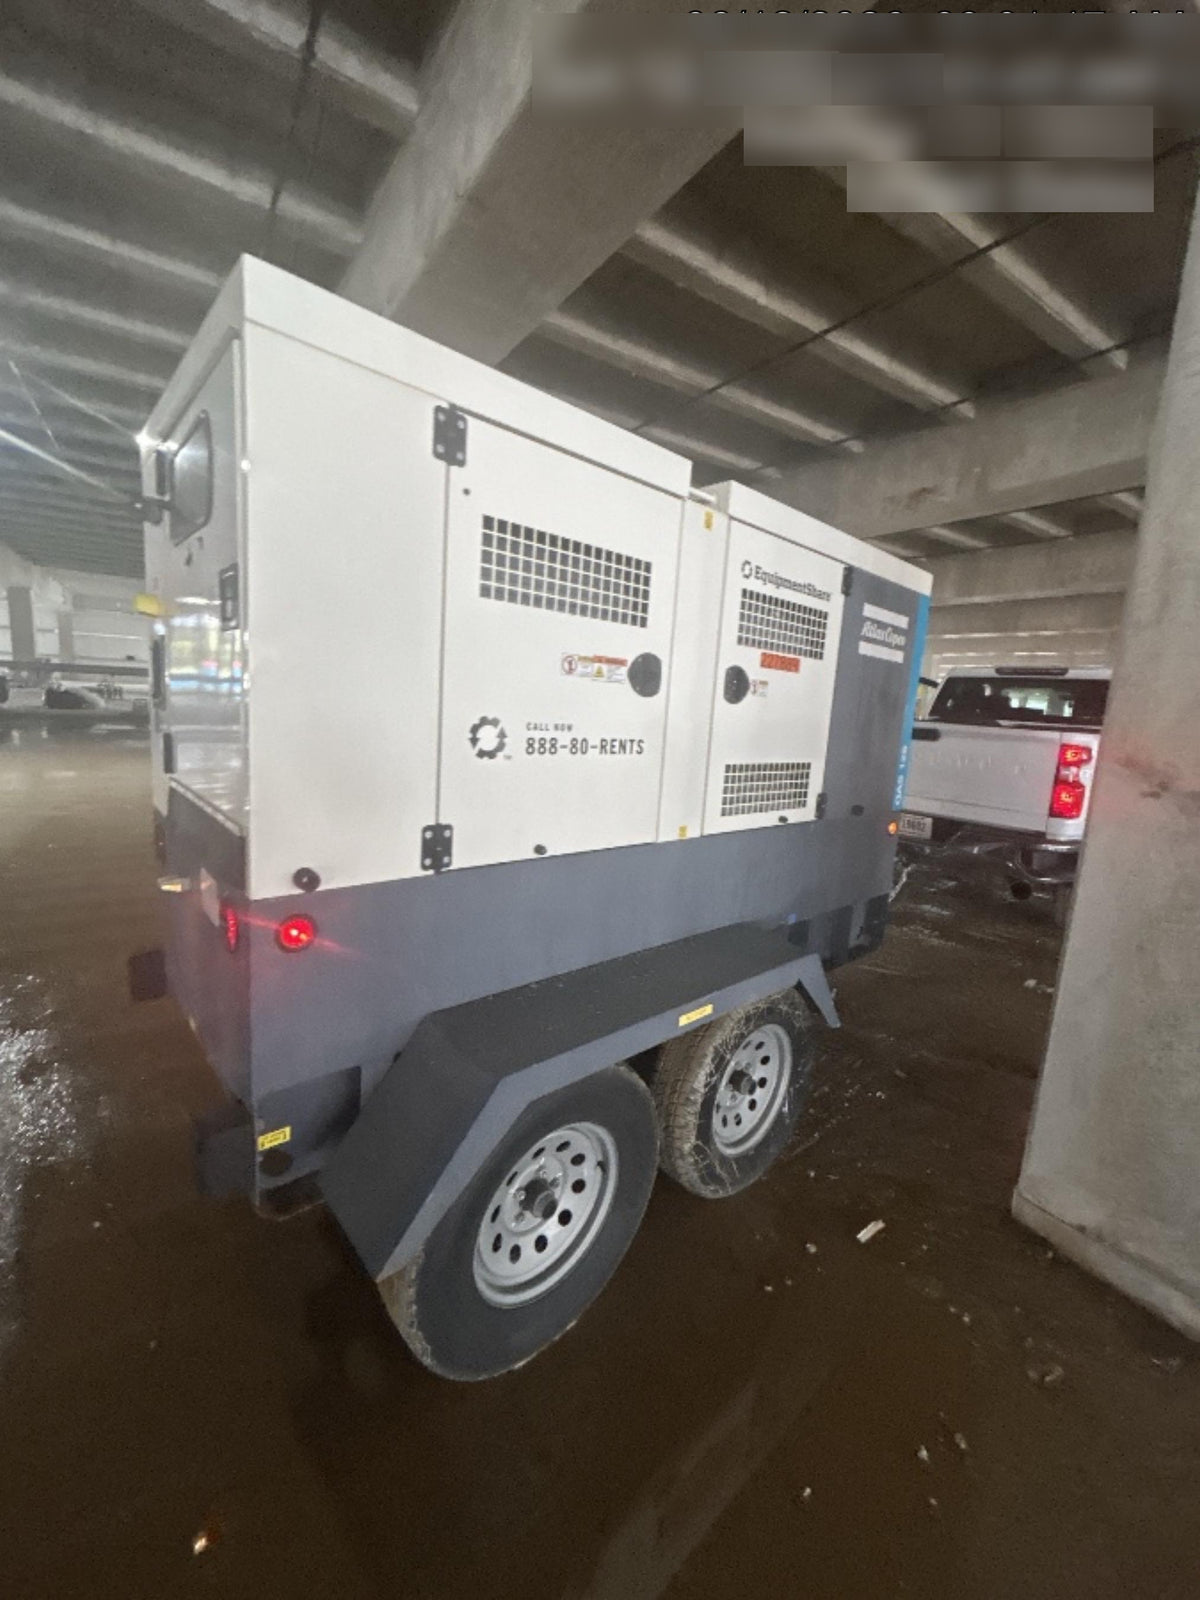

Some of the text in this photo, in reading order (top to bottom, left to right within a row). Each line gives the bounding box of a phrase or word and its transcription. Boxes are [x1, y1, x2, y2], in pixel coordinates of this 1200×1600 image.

[526, 722, 573, 733] CALL NOW
[525, 737, 645, 755] 888-80-RENTS
